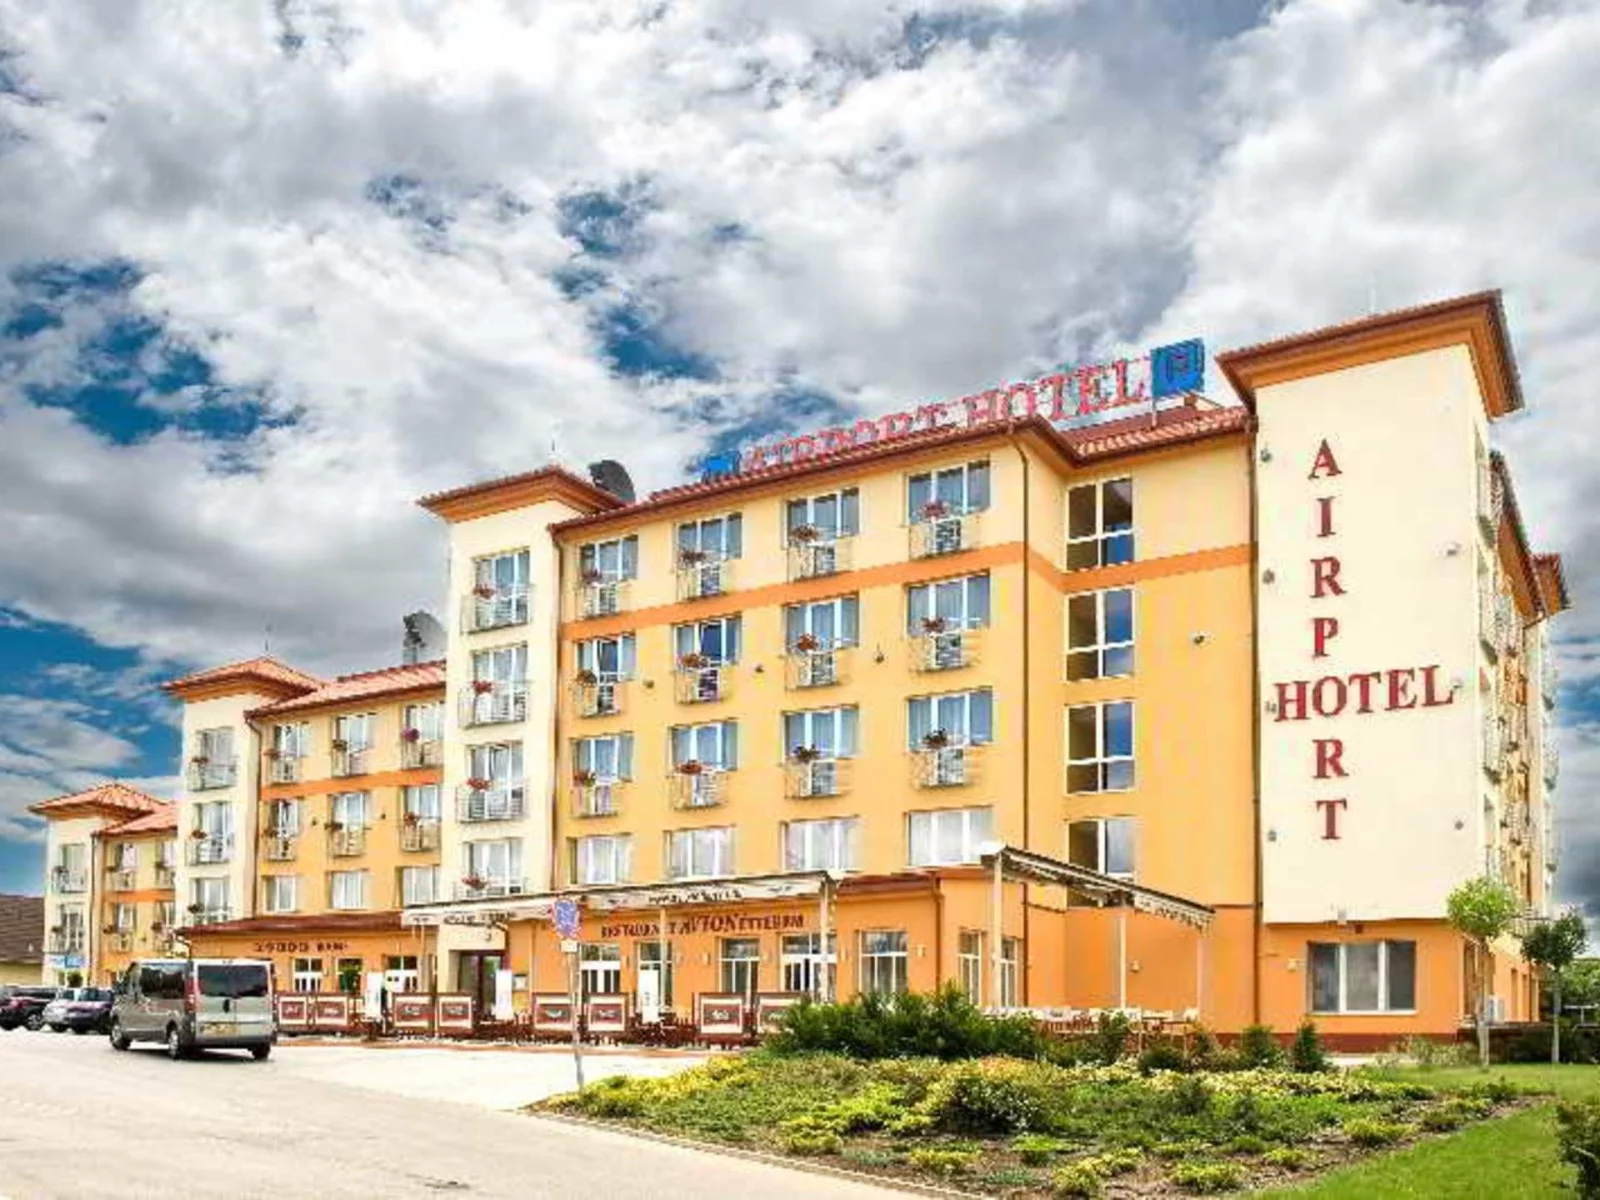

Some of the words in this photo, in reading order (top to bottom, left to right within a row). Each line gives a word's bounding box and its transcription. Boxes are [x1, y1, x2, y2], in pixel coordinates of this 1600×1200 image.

[962, 357, 1151, 424] HOTEL
[1308, 439, 1349, 840] AIRPORT
[1274, 664, 1454, 722] HOTEL
